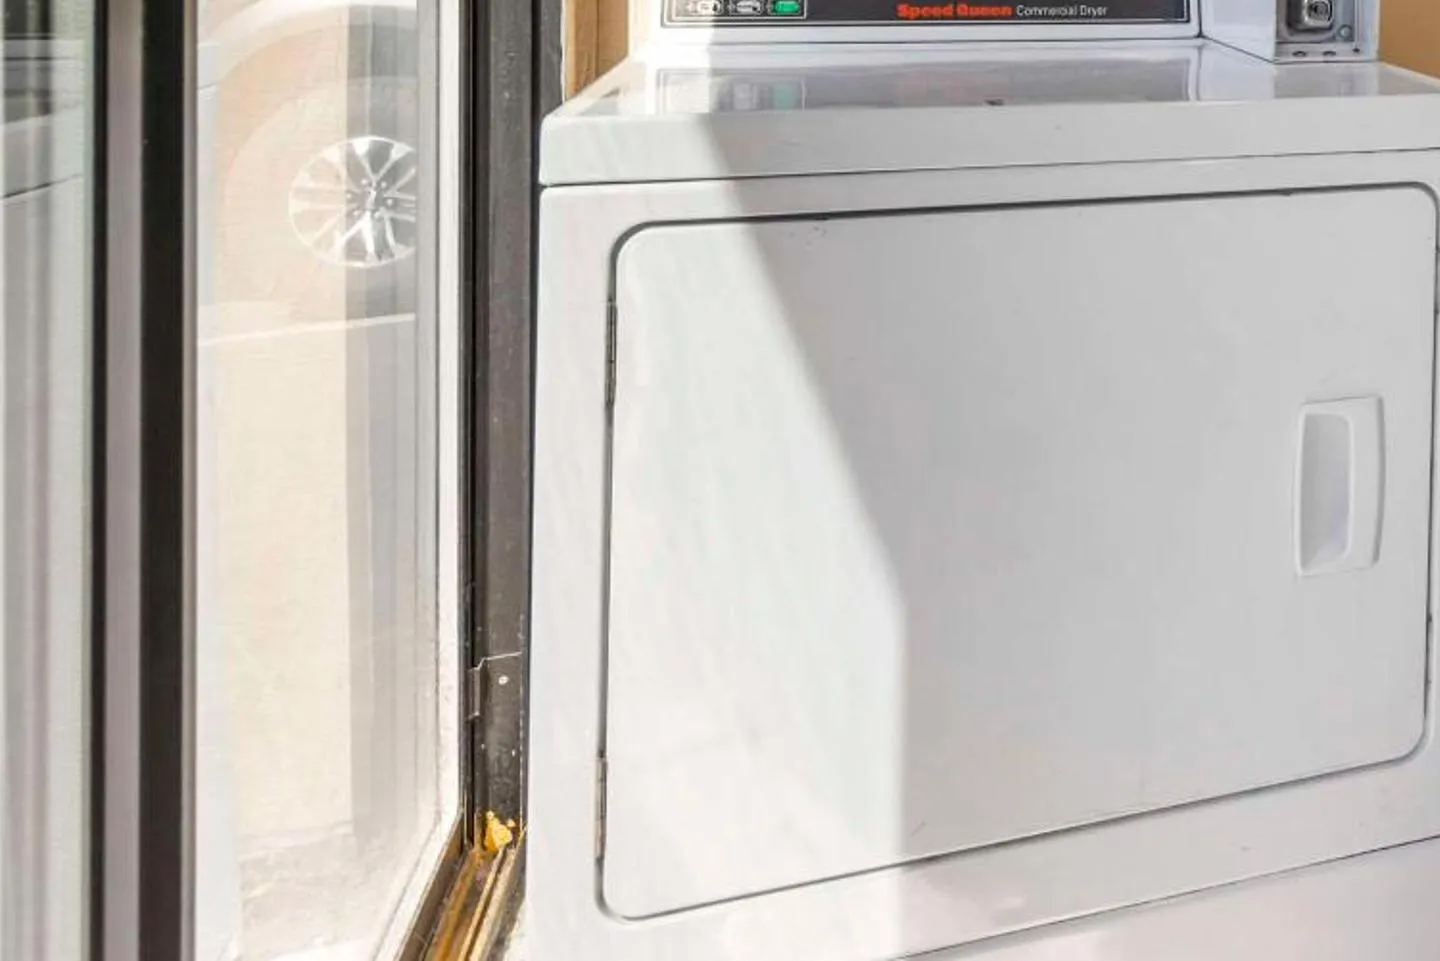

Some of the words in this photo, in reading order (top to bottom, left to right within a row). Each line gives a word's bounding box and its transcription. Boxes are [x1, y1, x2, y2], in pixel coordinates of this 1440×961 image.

[896, 3, 953, 19] Speed
[956, 3, 1013, 17] Queen
[1016, 4, 1077, 17] Commercial
[1079, 4, 1109, 19] Dryer
